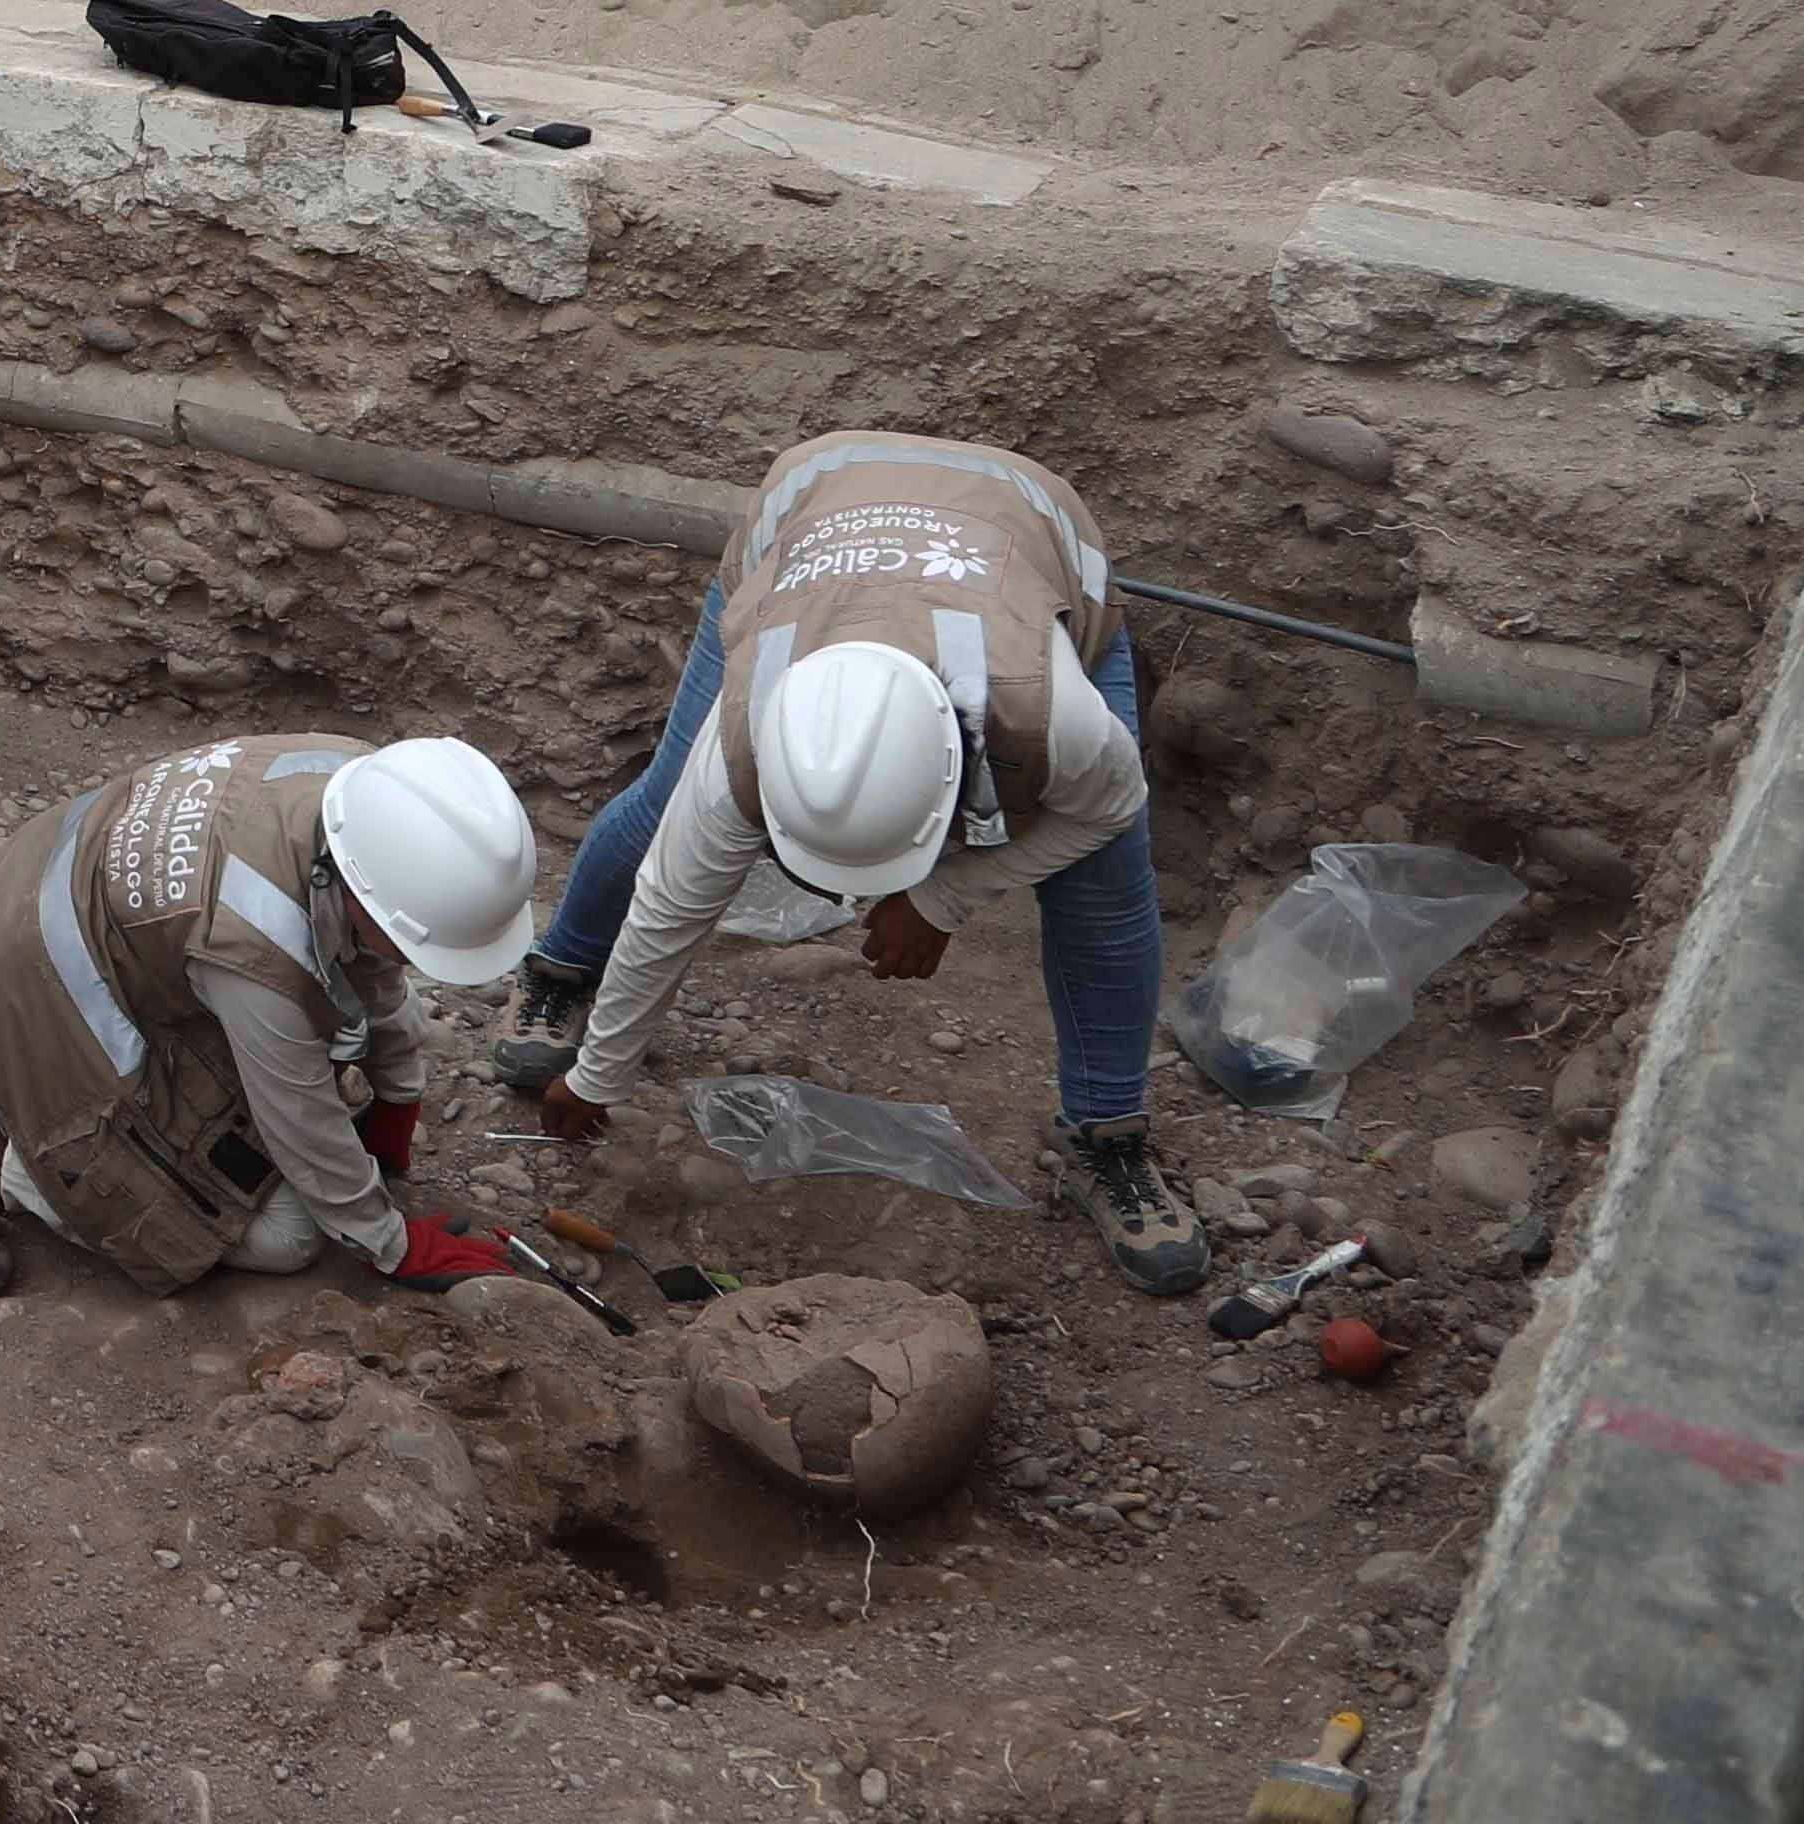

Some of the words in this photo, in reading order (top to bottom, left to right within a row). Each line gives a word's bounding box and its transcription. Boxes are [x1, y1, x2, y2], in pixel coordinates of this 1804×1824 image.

[814, 505, 935, 527] CONTRATISTA
[877, 536, 904, 546] GAS
[168, 778, 214, 901] Cálidda
